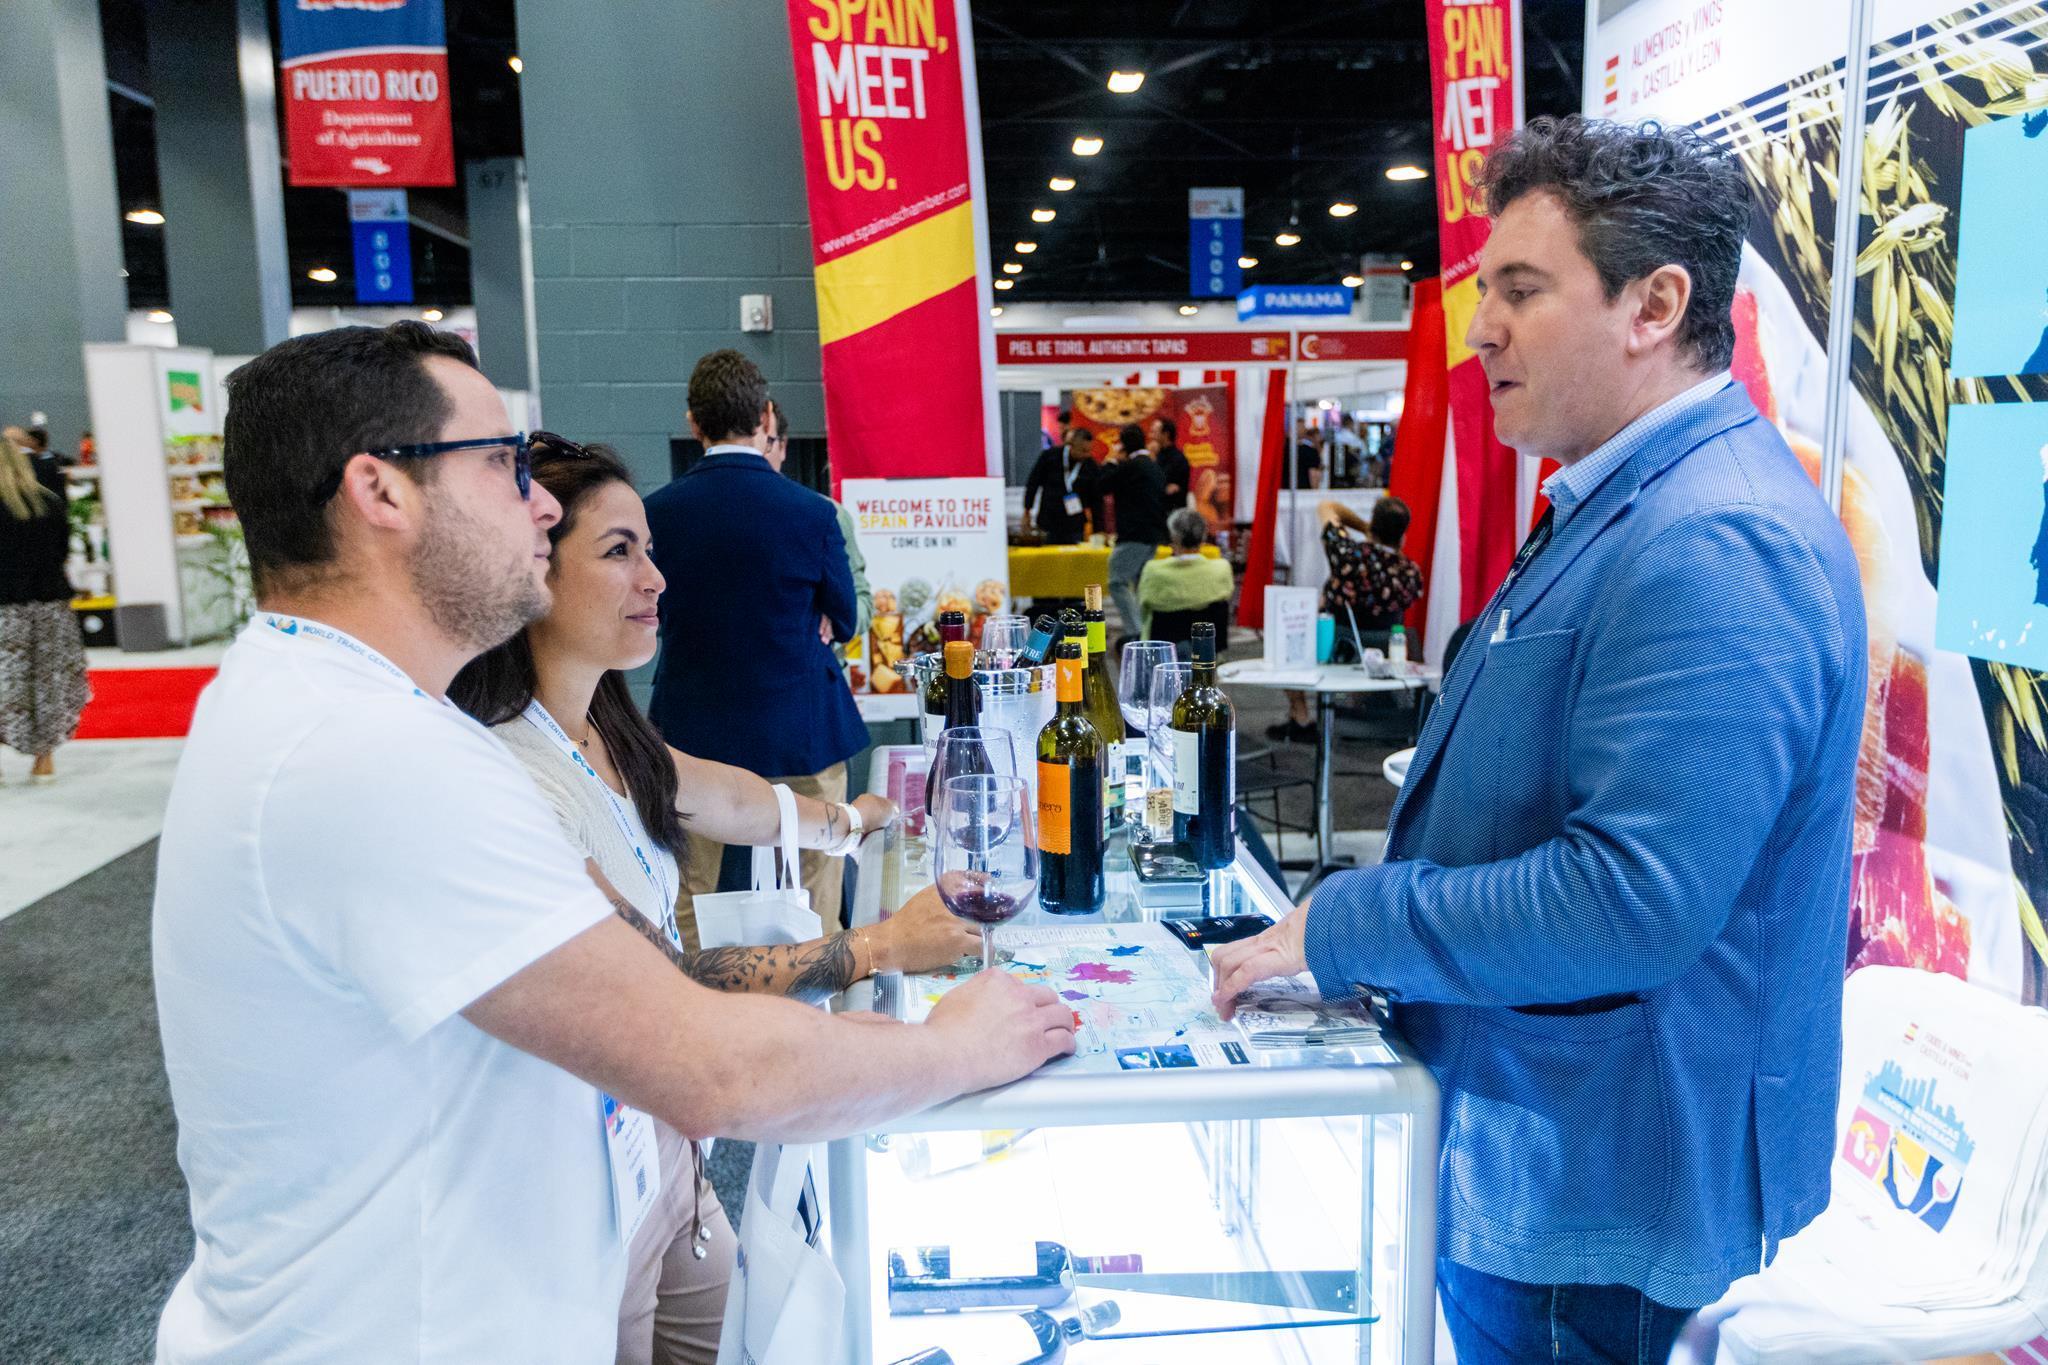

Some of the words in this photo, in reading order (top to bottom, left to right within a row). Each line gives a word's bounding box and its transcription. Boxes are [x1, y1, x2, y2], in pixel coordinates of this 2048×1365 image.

[1632, 20, 1683, 69] ALIMENTOS
[293, 69, 380, 101] PUERTO
[385, 69, 439, 102] RICO
[812, 41, 930, 120] MEET
[322, 110, 413, 128] Department
[316, 131, 334, 146] of
[338, 130, 422, 149] Agriculture
[820, 118, 898, 191] US.
[820, 183, 969, 254] www.spainuschamber.com
[1264, 292, 1345, 309] PANAMA
[1009, 340, 1034, 356] PIEL
[1036, 340, 1053, 356] DE
[1089, 339, 1151, 355] AUTHENTIC
[1152, 339, 1188, 355] TAPAS
[856, 499, 932, 514] WELCOME
[939, 499, 957, 513] TO
[963, 498, 991, 513] THE
[859, 514, 908, 529] SPAIN
[914, 513, 988, 528] PAVILION
[891, 537, 919, 549] COME
[924, 537, 938, 548] ON
[942, 536, 957, 548] IN!
[303, 625, 335, 640] WORLD
[337, 635, 366, 657] TRADE
[368, 654, 405, 679] CENTER
[531, 703, 549, 722] TRADE
[547, 721, 569, 744] CENTER
